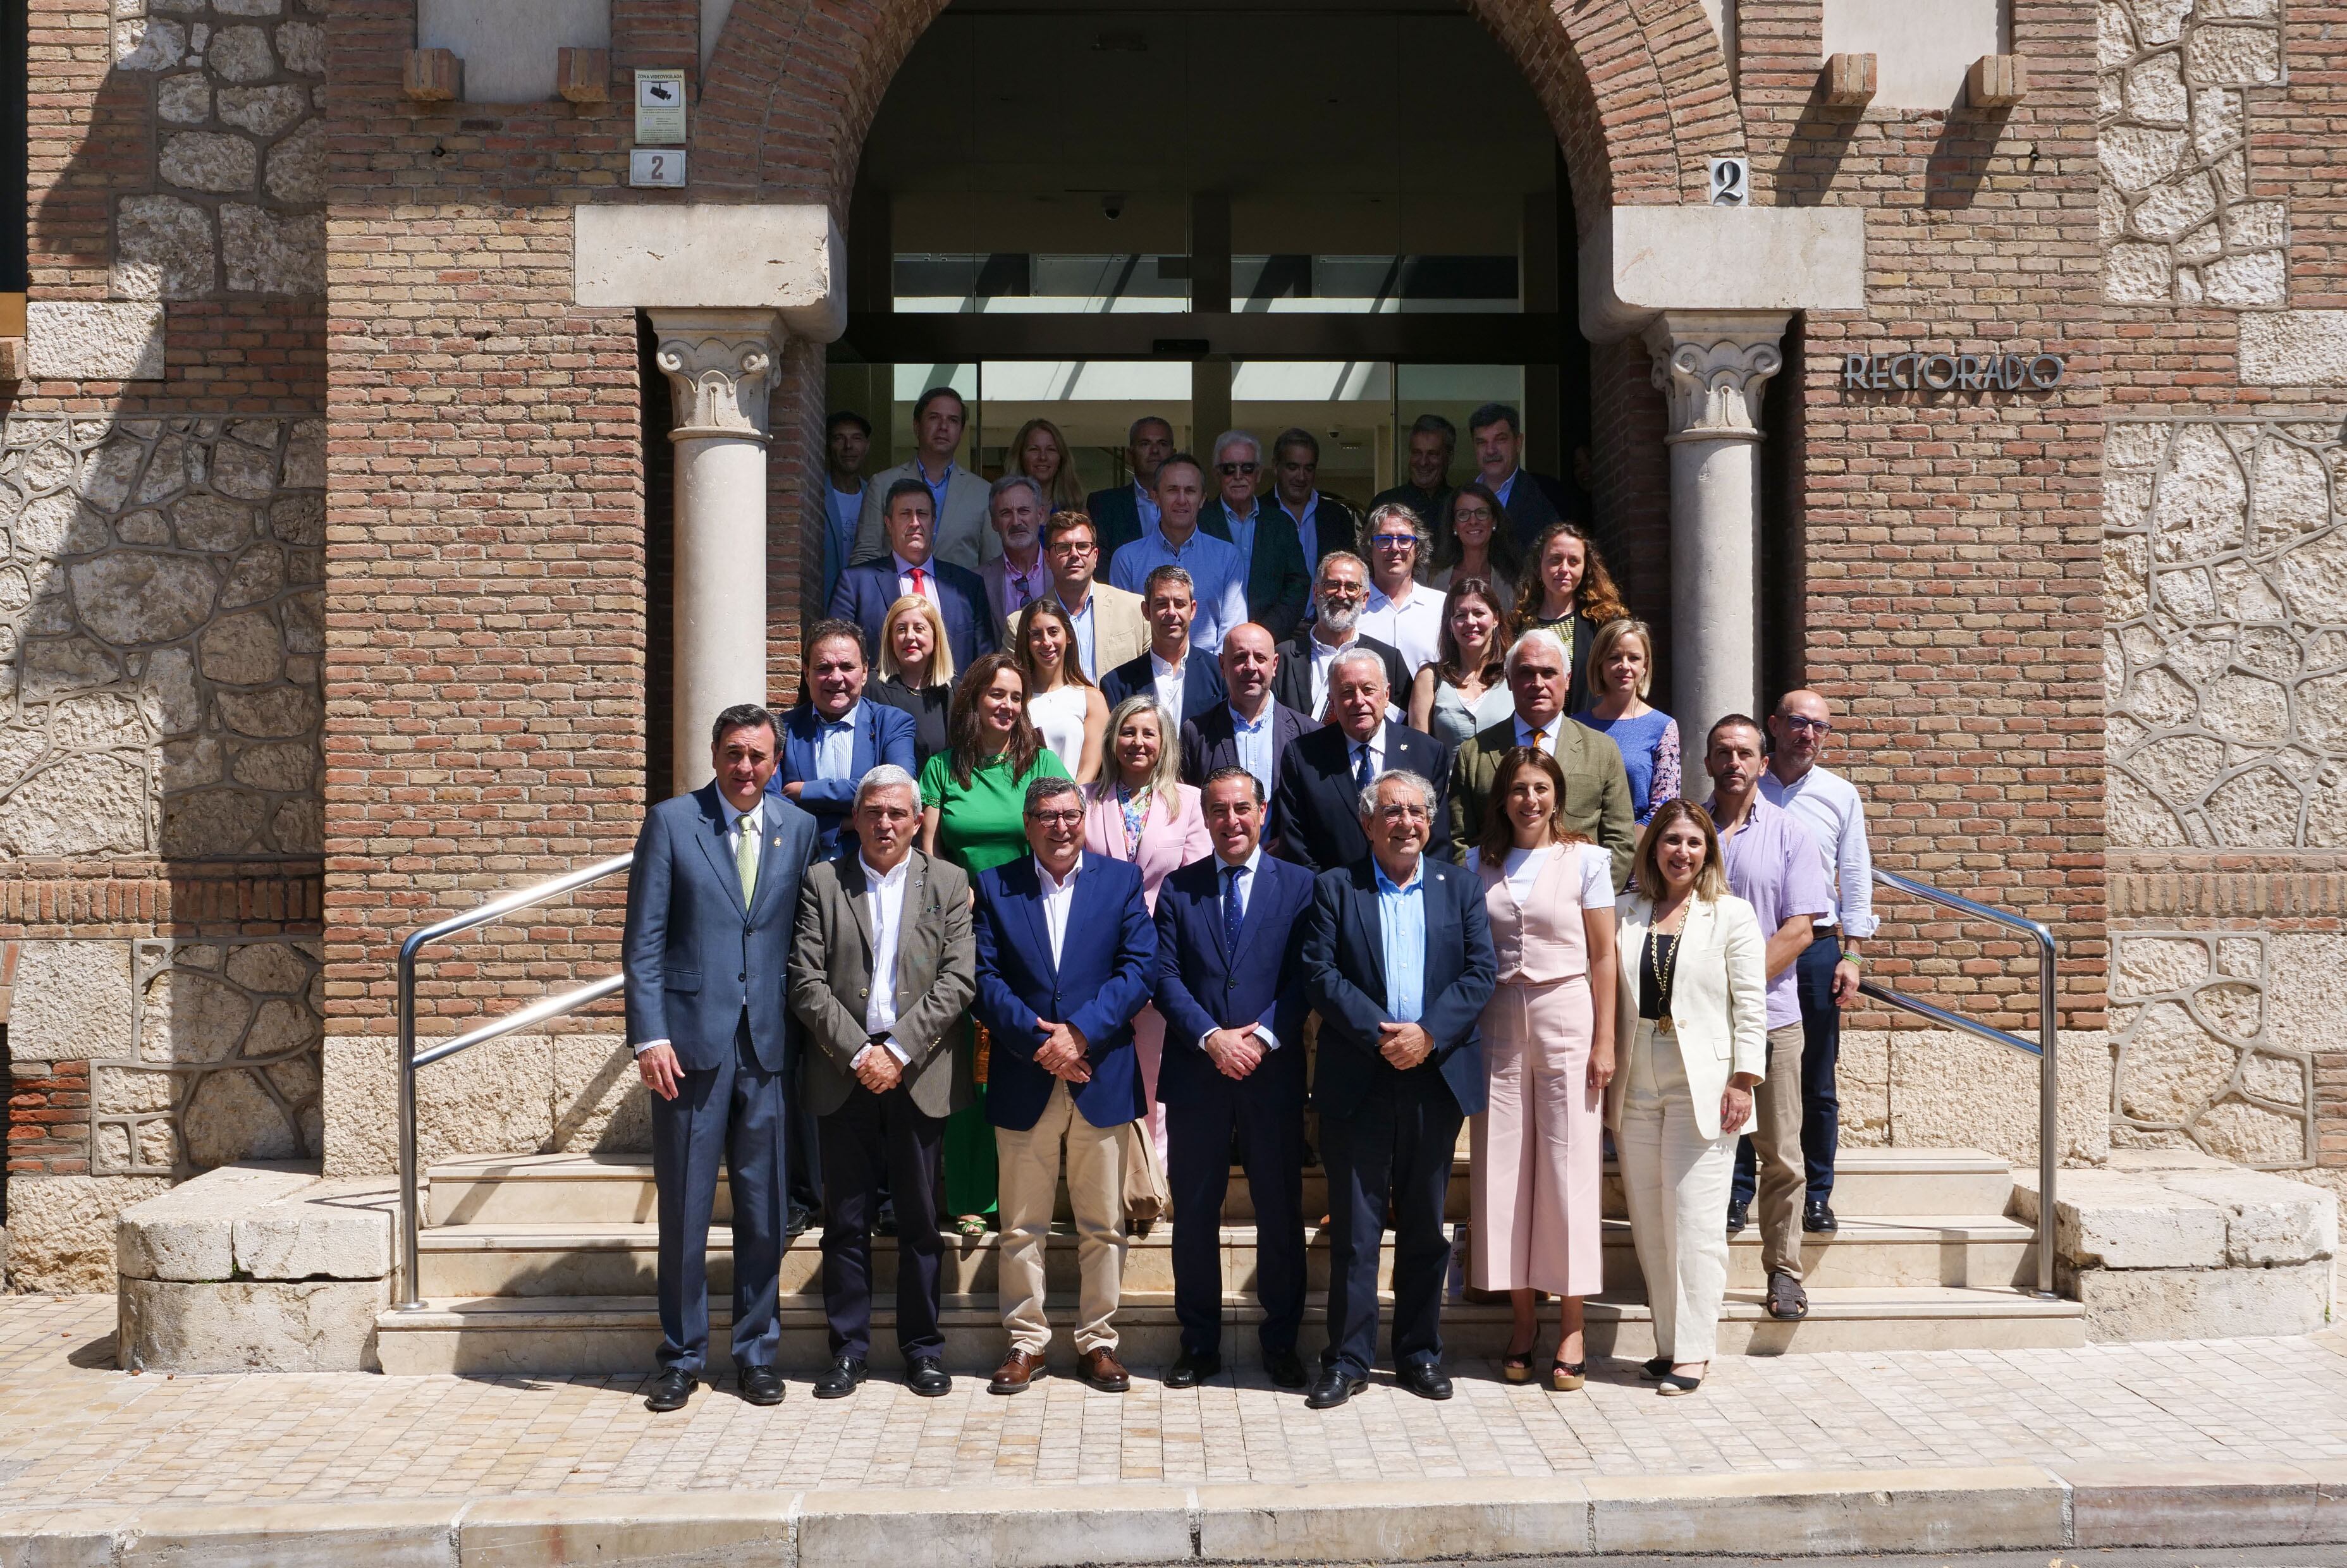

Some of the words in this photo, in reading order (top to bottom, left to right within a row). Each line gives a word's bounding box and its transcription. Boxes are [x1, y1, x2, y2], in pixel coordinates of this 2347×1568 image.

[651, 156, 663, 180] 2
[1713, 161, 1743, 205] 2
[1844, 353, 2063, 389] RECTORADO
